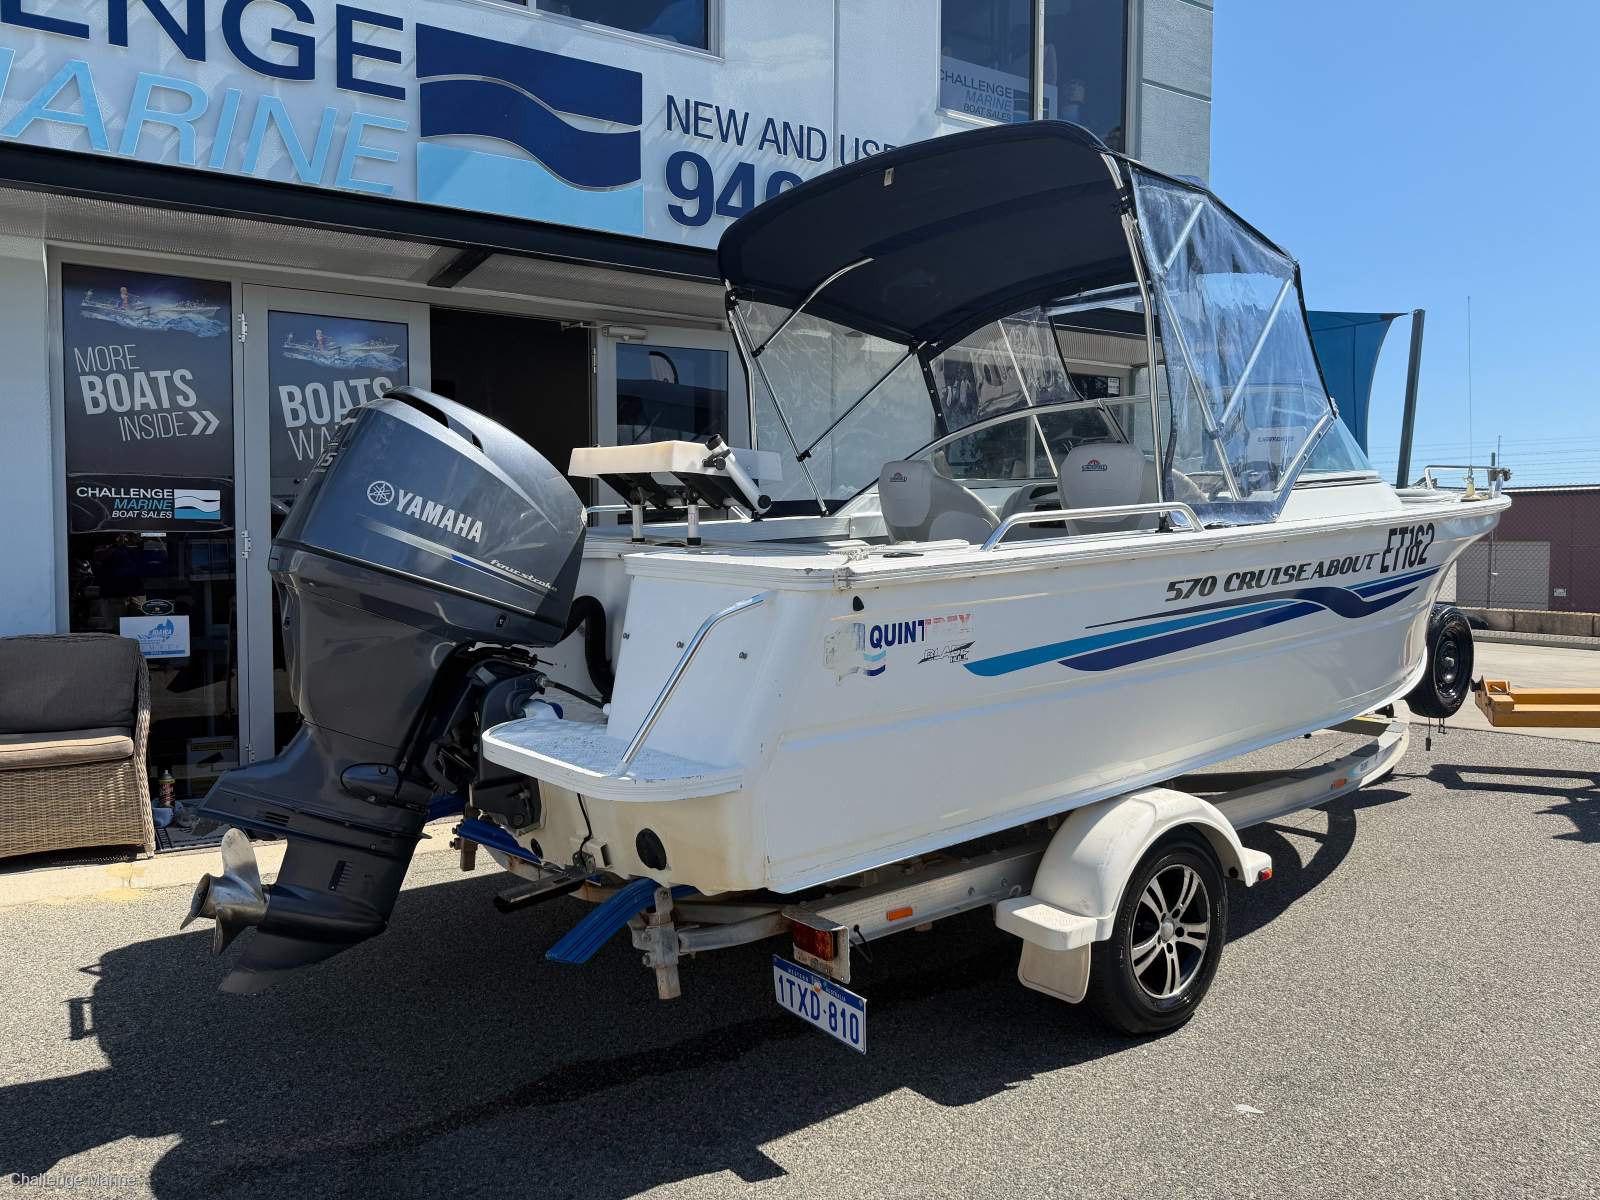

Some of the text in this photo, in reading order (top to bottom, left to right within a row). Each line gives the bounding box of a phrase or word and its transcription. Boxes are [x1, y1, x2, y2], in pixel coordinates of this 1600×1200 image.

[963, 103, 1011, 121] BOAT SALES
[965, 90, 1013, 113] MARINE
[0, 47, 410, 196] ARINE
[666, 94, 749, 147] NEW
[758, 117, 828, 163] AND
[74, 344, 141, 373] MORE
[79, 369, 197, 415] BOATS
[119, 411, 188, 441] INSIDE
[76, 487, 173, 499] CHALLENGE
[114, 499, 172, 510] MARINE
[111, 510, 173, 519] BOAT SALES
[395, 488, 484, 543] YAMAHA
[1165, 575, 1218, 602] 570
